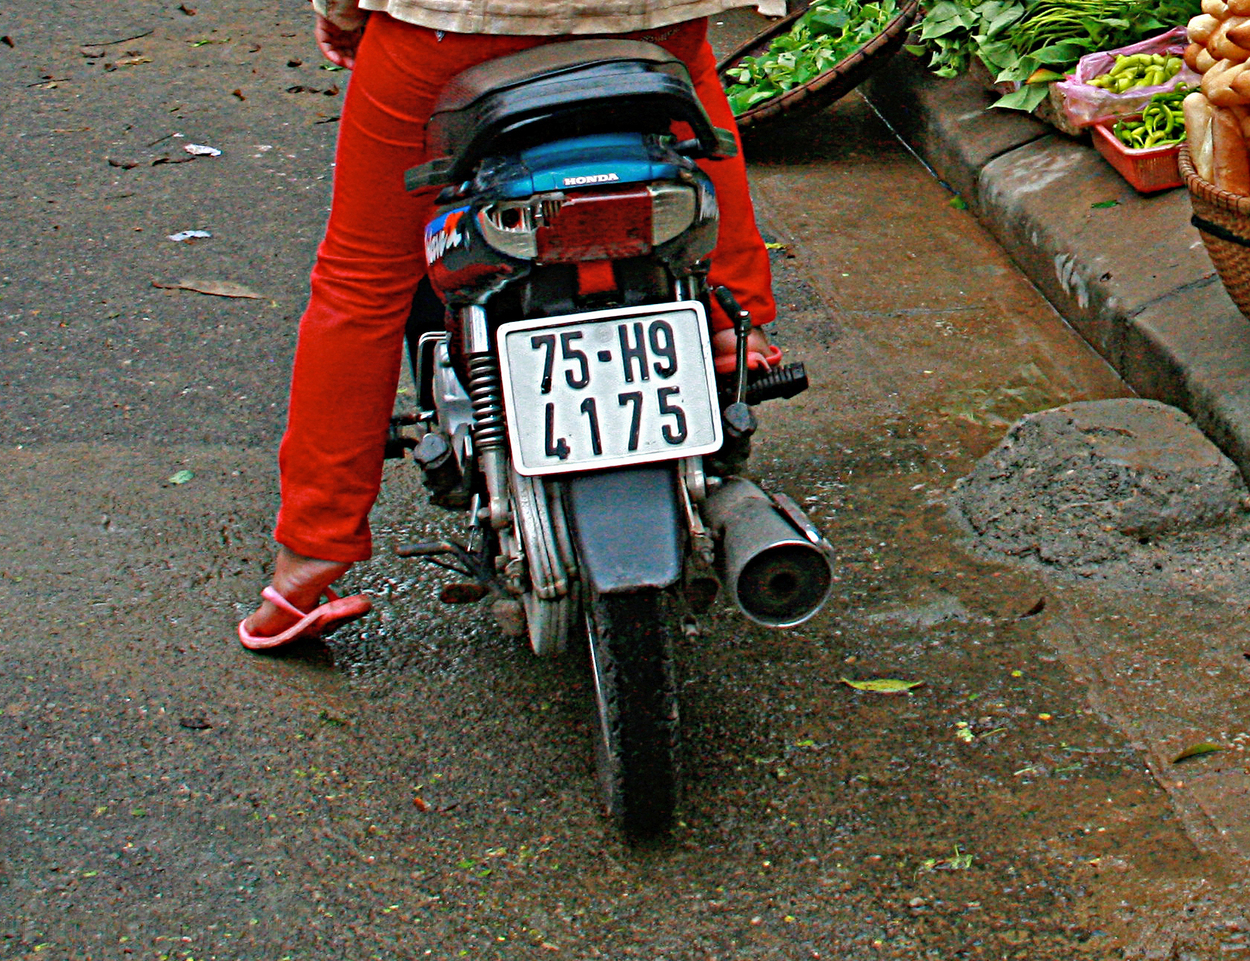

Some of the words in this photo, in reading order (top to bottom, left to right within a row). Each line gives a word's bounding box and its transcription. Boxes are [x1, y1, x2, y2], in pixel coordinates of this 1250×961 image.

[563, 172, 620, 186] HONDA
[530, 319, 678, 395] 75-H9
[544, 385, 688, 460] 4175
